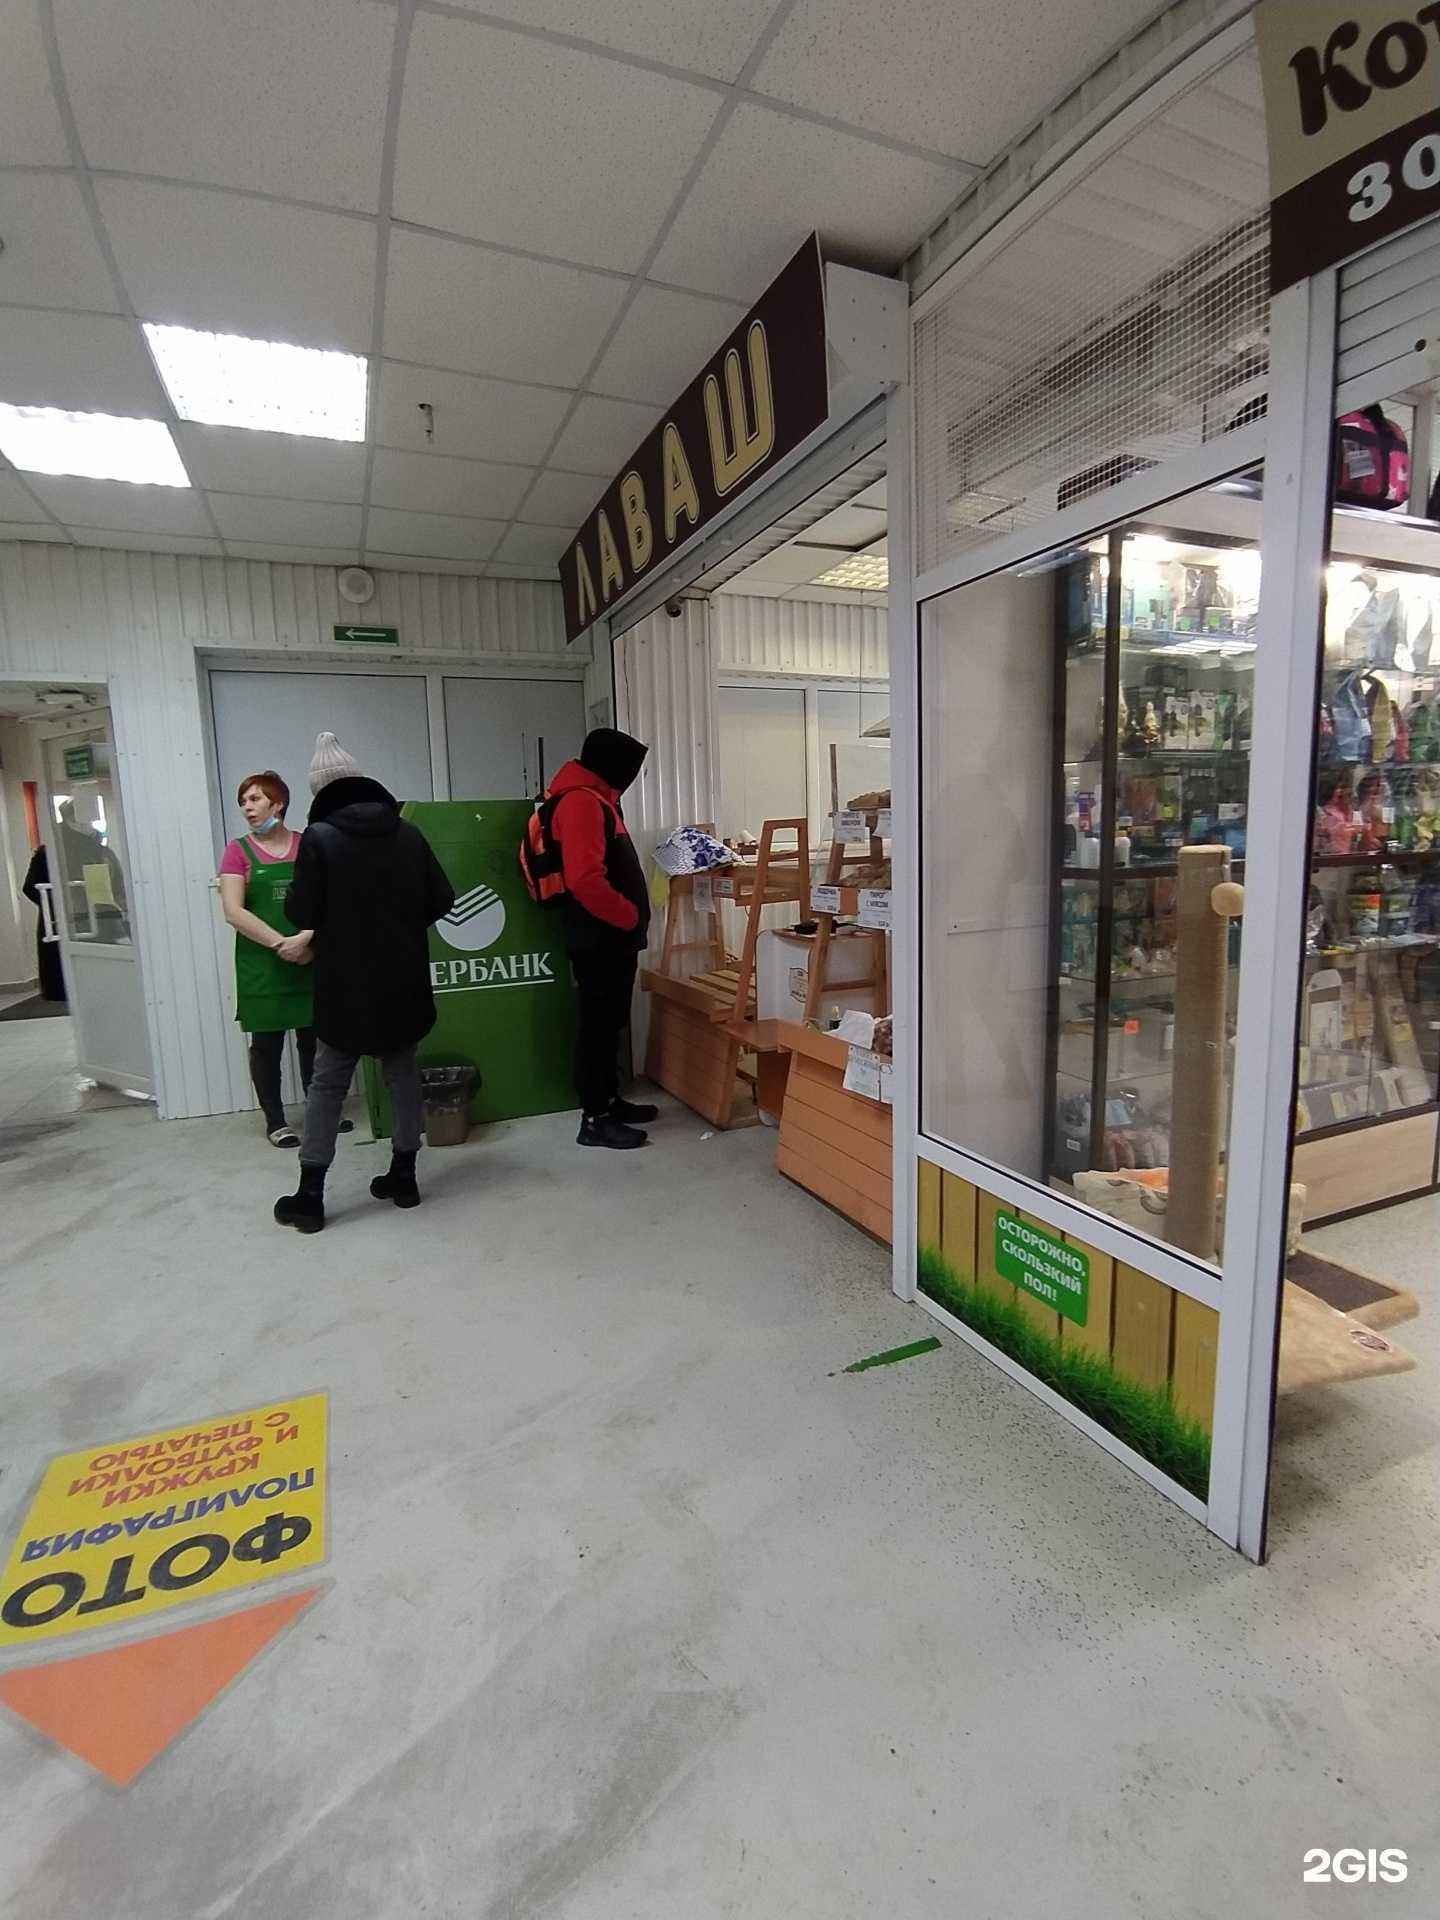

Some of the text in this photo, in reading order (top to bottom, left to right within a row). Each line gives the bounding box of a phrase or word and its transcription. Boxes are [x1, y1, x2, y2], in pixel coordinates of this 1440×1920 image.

[575, 318, 776, 626] ЛАВАШ
[429, 952, 554, 986] ЕРБАНК
[998, 1216, 1086, 1277] ОСТОРОЖНО,
[1001, 1239, 1082, 1295] СКОЛЬЗКИЙ
[1024, 1272, 1057, 1301] ПОЛ!
[67, 1424, 299, 1497] И ФУТБОЛКИ
[88, 1411, 291, 1472] С ПЕЧАТЬЮ
[102, 1452, 260, 1509] КРУЖКИ
[20, 1467, 315, 1563] ПОЛИГРАФИЯ
[1, 1511, 313, 1628] ФОТО
